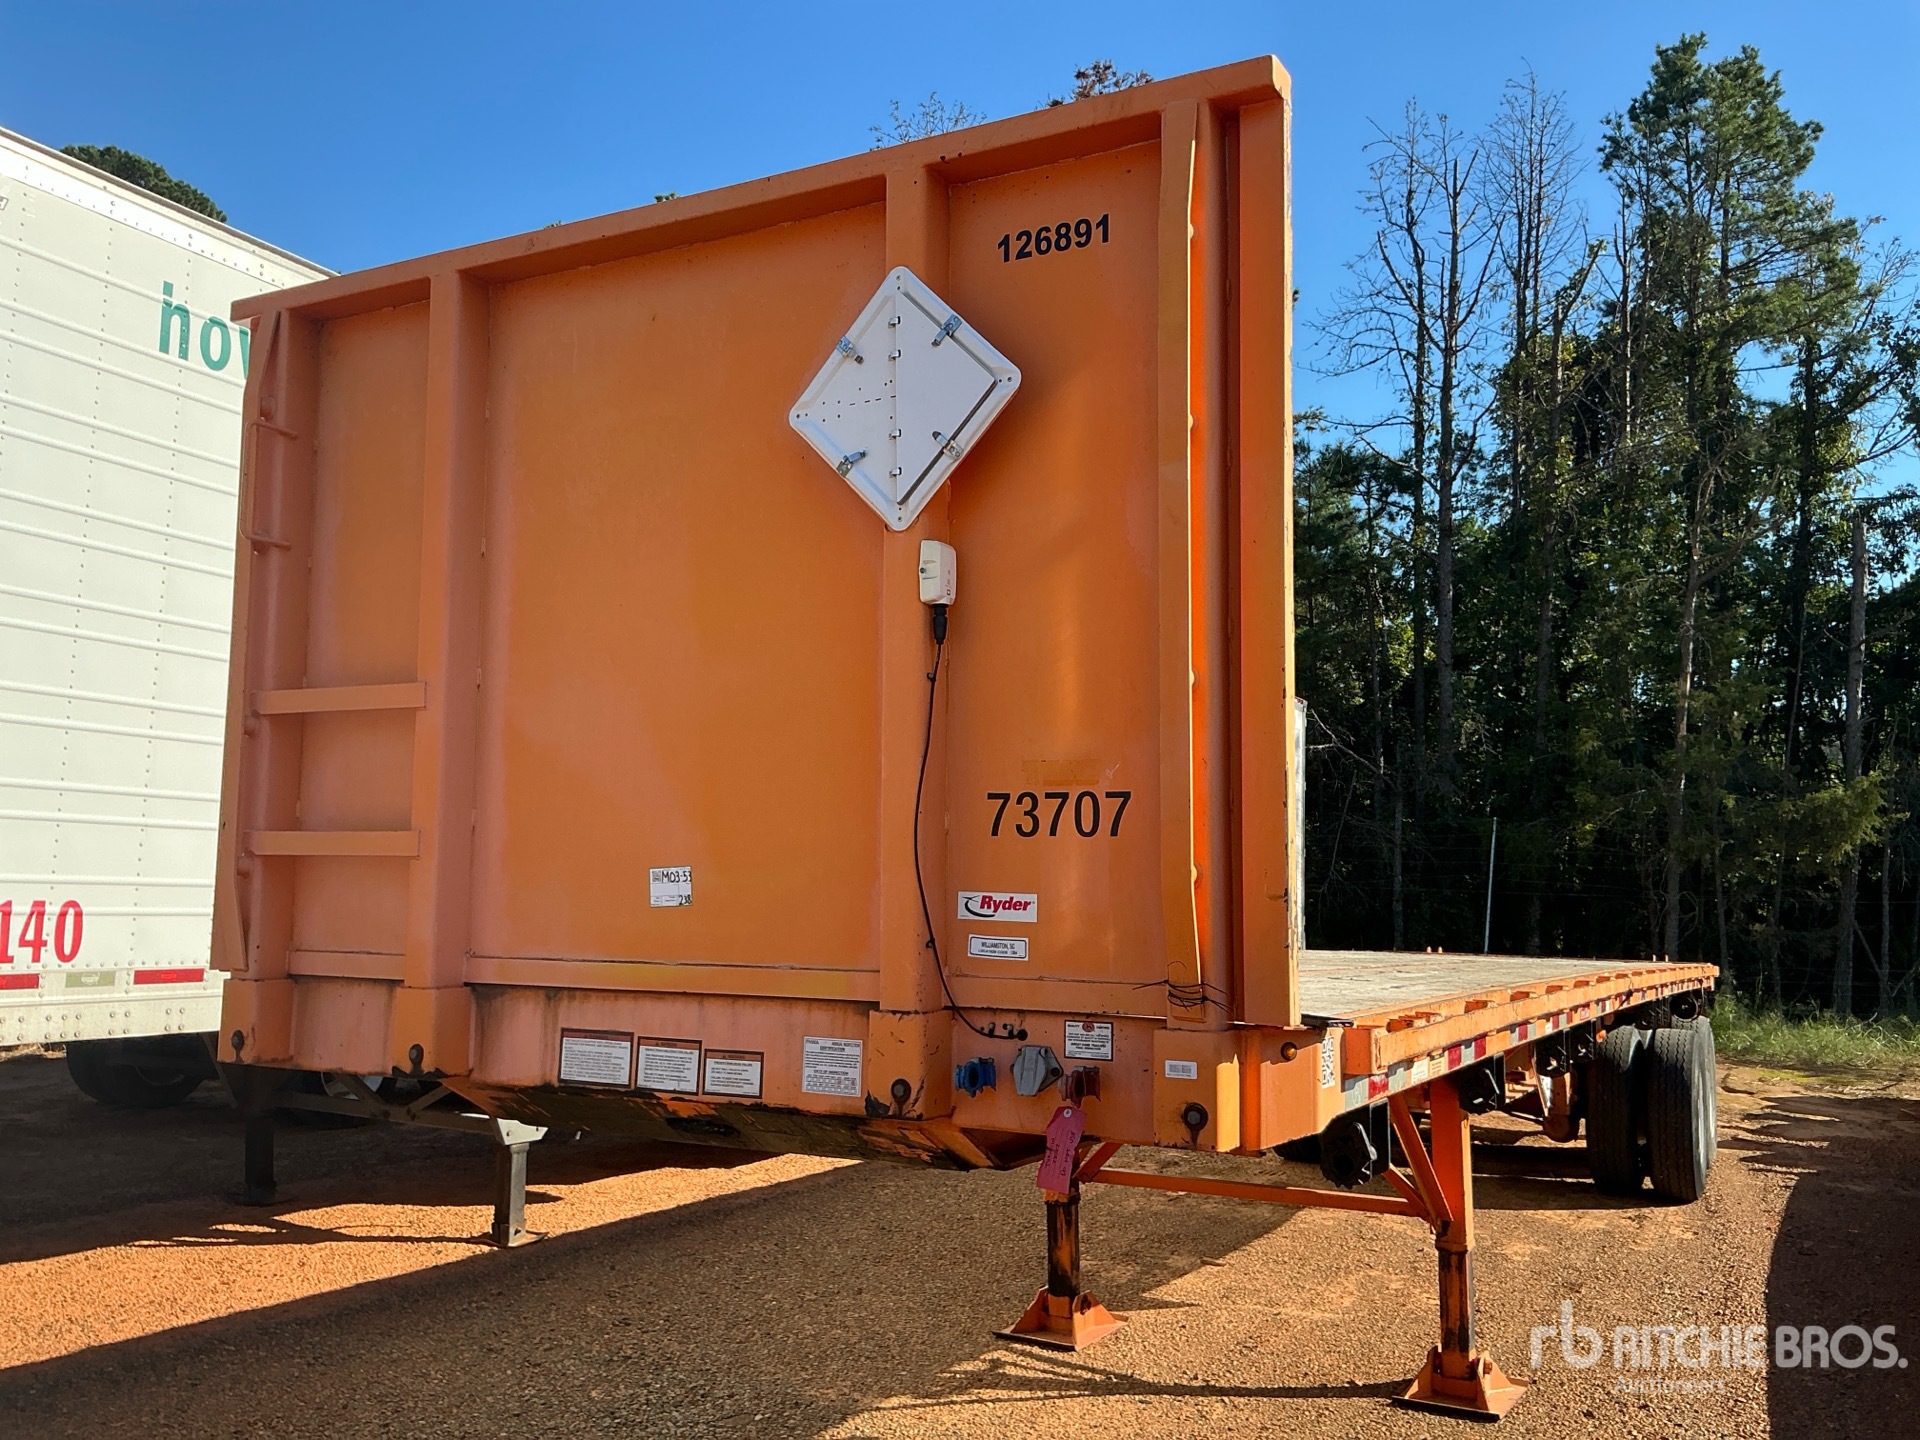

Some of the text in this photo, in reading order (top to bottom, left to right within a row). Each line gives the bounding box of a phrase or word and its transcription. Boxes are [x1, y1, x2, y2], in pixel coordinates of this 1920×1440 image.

[998, 213, 1109, 263] 126891
[987, 790, 1131, 838] 73707
[980, 895, 1031, 913] Ryder
[0, 900, 83, 963] 140
